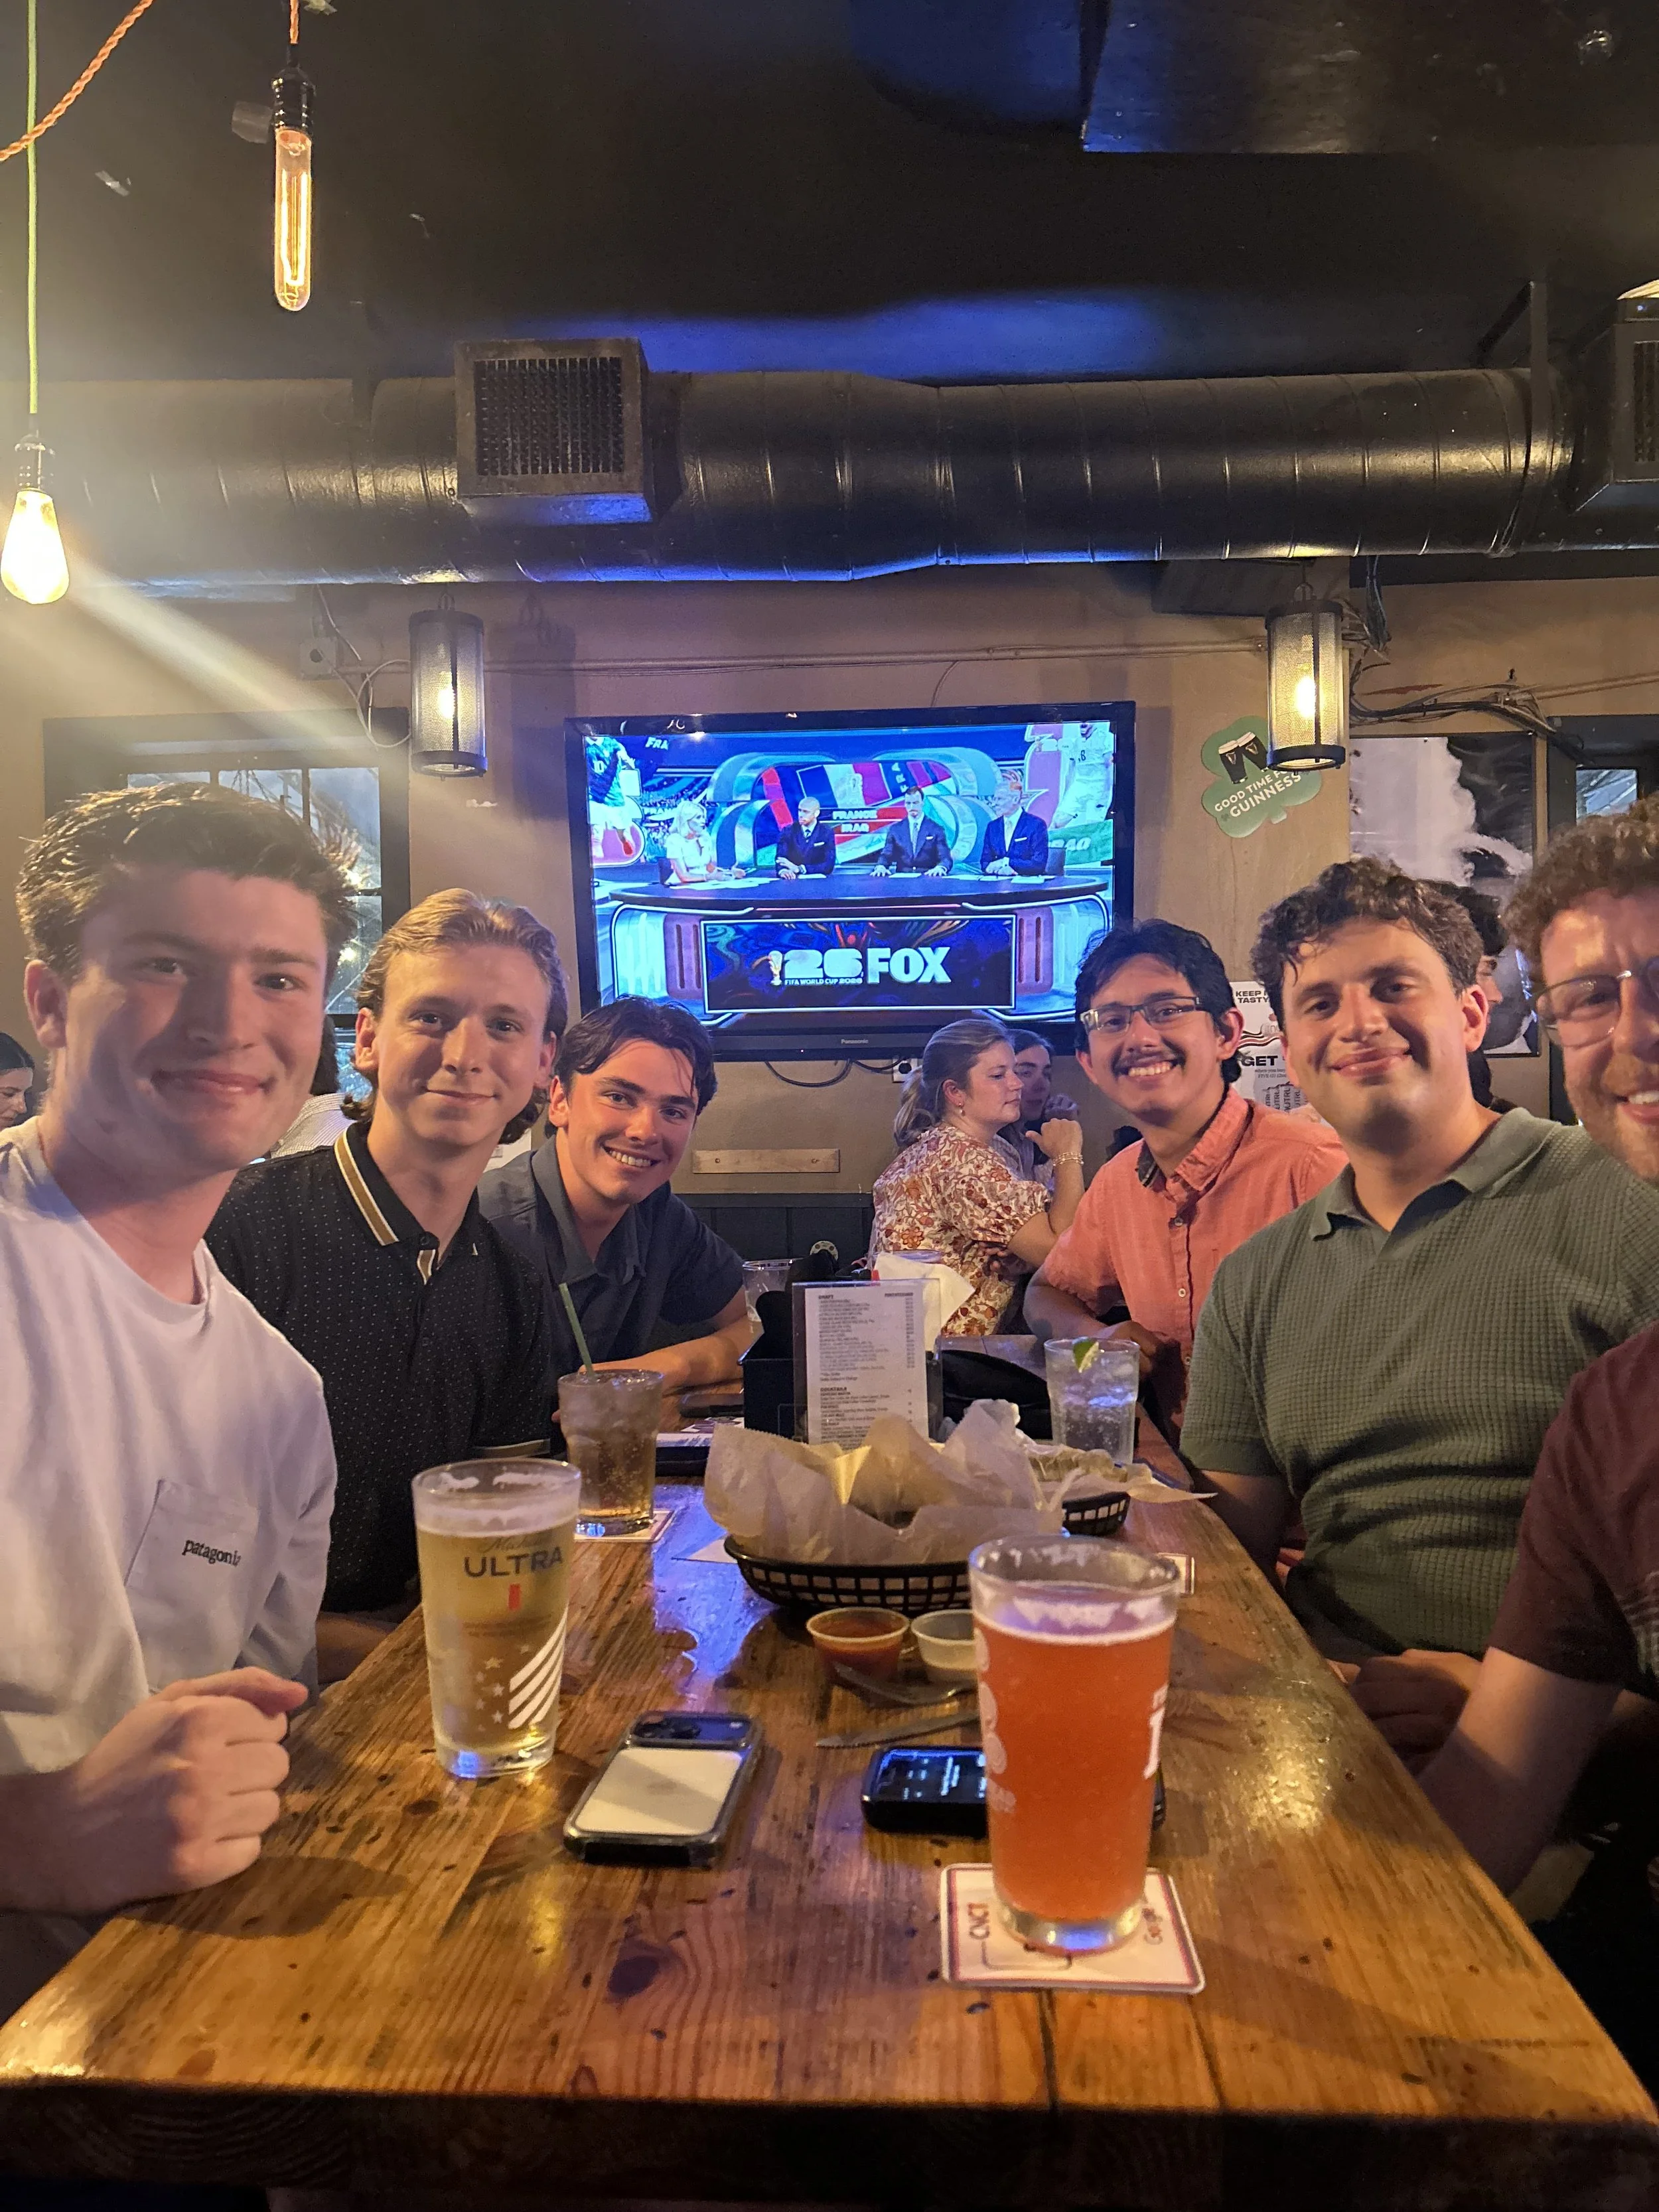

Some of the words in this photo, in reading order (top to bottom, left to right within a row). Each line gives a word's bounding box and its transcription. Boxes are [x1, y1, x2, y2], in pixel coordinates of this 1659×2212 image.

[1214, 790, 1245, 812] GOOD
[1246, 774, 1275, 793] TIME
[1230, 773, 1301, 817] GUINNESS
[867, 947, 952, 984] FOX
[1241, 1055, 1278, 1067] GET
[464, 1546, 563, 1577] ULTRA
